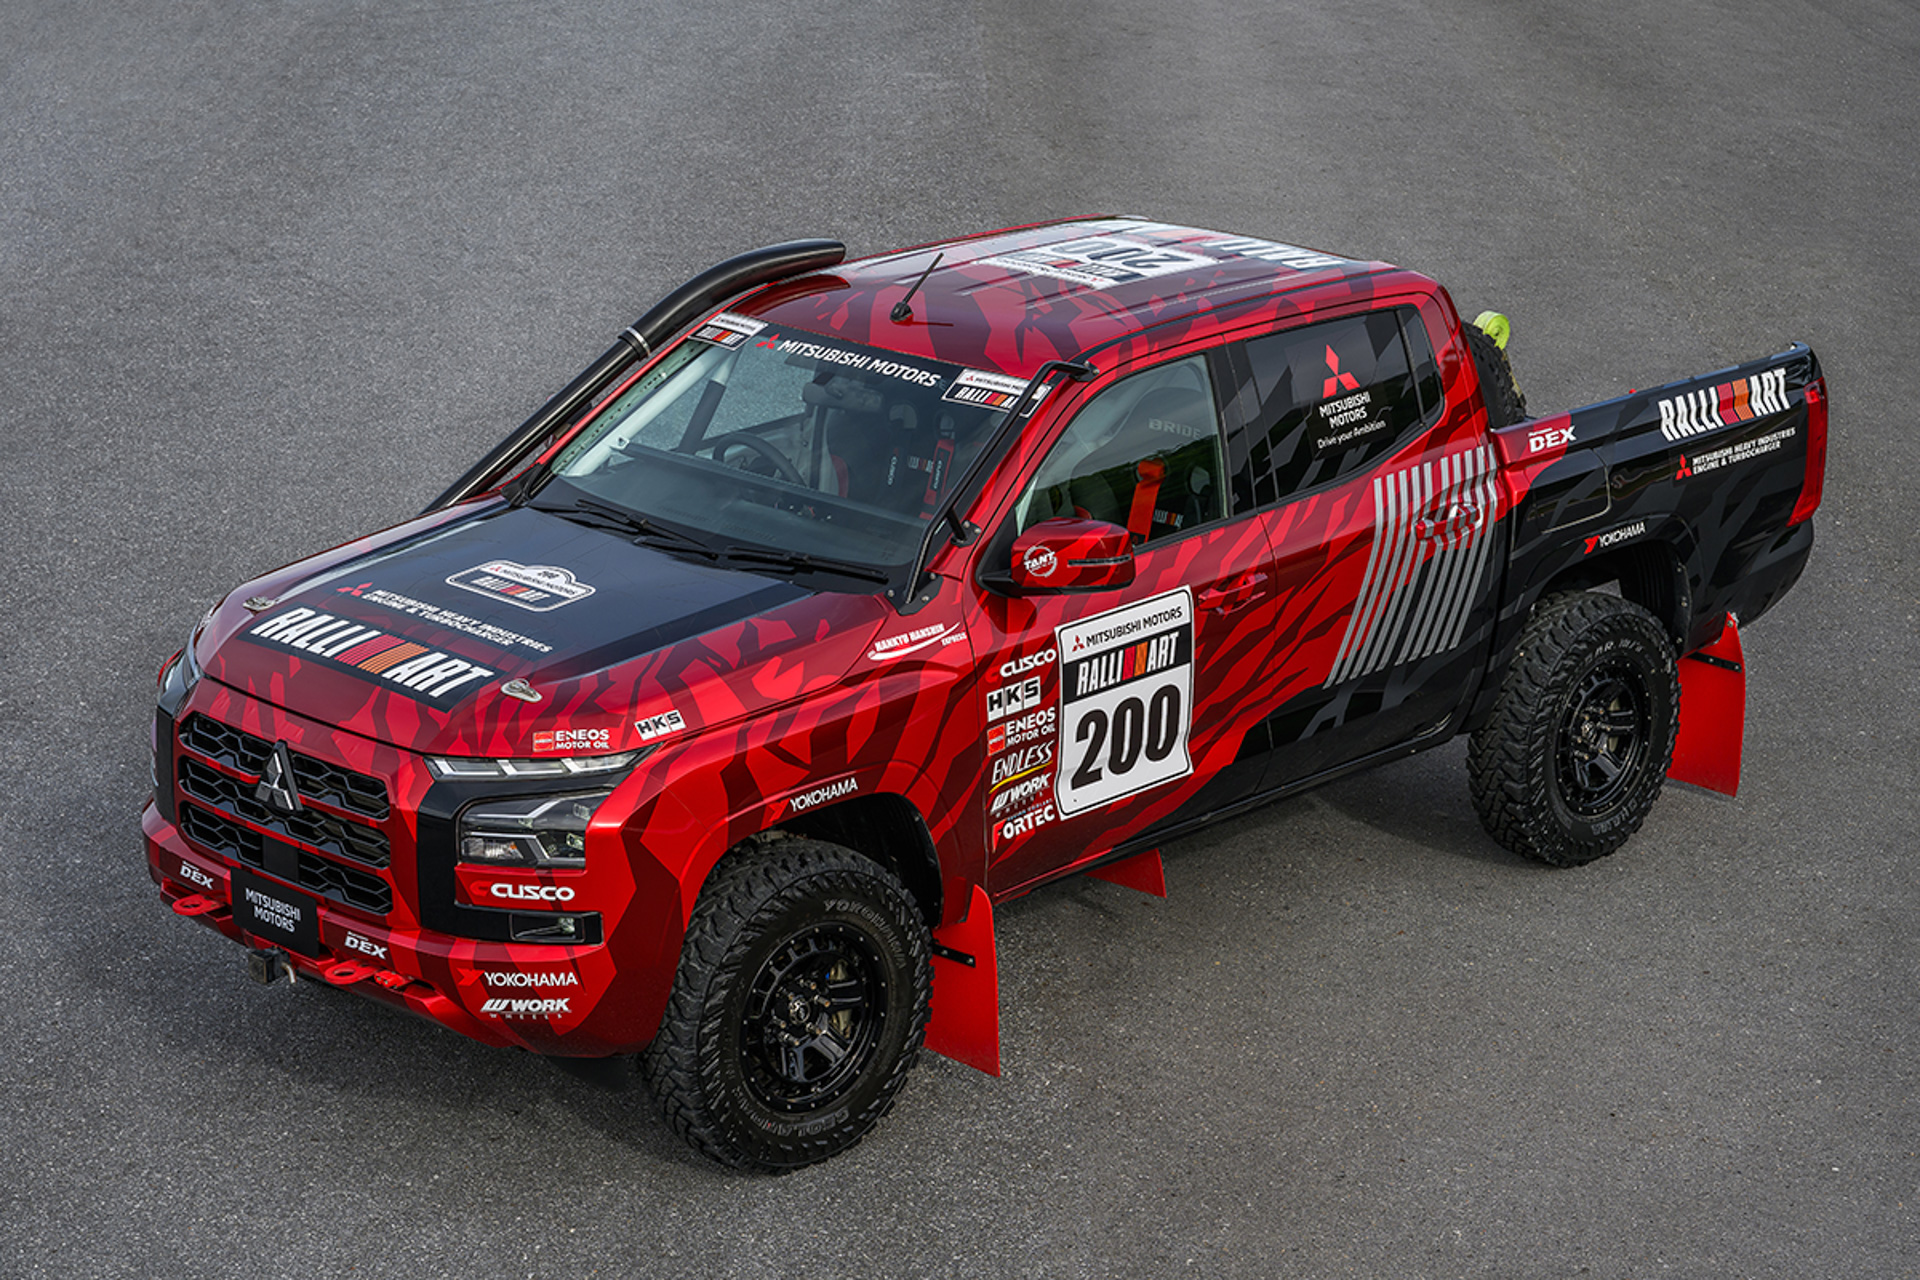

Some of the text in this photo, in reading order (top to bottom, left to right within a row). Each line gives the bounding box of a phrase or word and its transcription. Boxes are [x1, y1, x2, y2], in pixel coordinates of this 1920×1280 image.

[776, 339, 869, 369] MITSUBISHI
[865, 358, 943, 388] MOTORS
[1319, 391, 1372, 418] MITSUBISHI
[1329, 406, 1368, 429] MOTORS
[1657, 367, 1791, 442] RALLIART
[1148, 418, 1201, 440] BRIDE
[1317, 436, 1337, 449] Drive
[1337, 430, 1353, 445] your
[1529, 425, 1577, 453] DEX
[1599, 521, 1646, 547] YOKOHAMA
[1085, 606, 1183, 647] MITSUBISHI MOTORS
[250, 607, 495, 698] RALLIART
[1000, 648, 1057, 678] CUSCO
[1077, 631, 1180, 697] RALLIART
[988, 680, 1039, 712] HKS
[636, 711, 682, 734] HKS
[1005, 706, 1056, 736] ENEOS
[555, 729, 610, 742] ENEOS
[555, 741, 591, 750] MOTOR
[1006, 728, 1040, 748] MOTOR
[1070, 684, 1182, 791] 200
[992, 739, 1055, 785] ENDLESS
[789, 777, 859, 813] YOKOHAMA
[1010, 772, 1052, 803] WORK
[179, 865, 214, 890] DEX
[245, 887, 302, 922] MITSUBISHI
[490, 883, 576, 901] CUSCO
[253, 906, 296, 934] MOTORS
[344, 934, 388, 960] DEX
[484, 971, 579, 988] YOKOHAMA
[509, 998, 571, 1012] WORK
